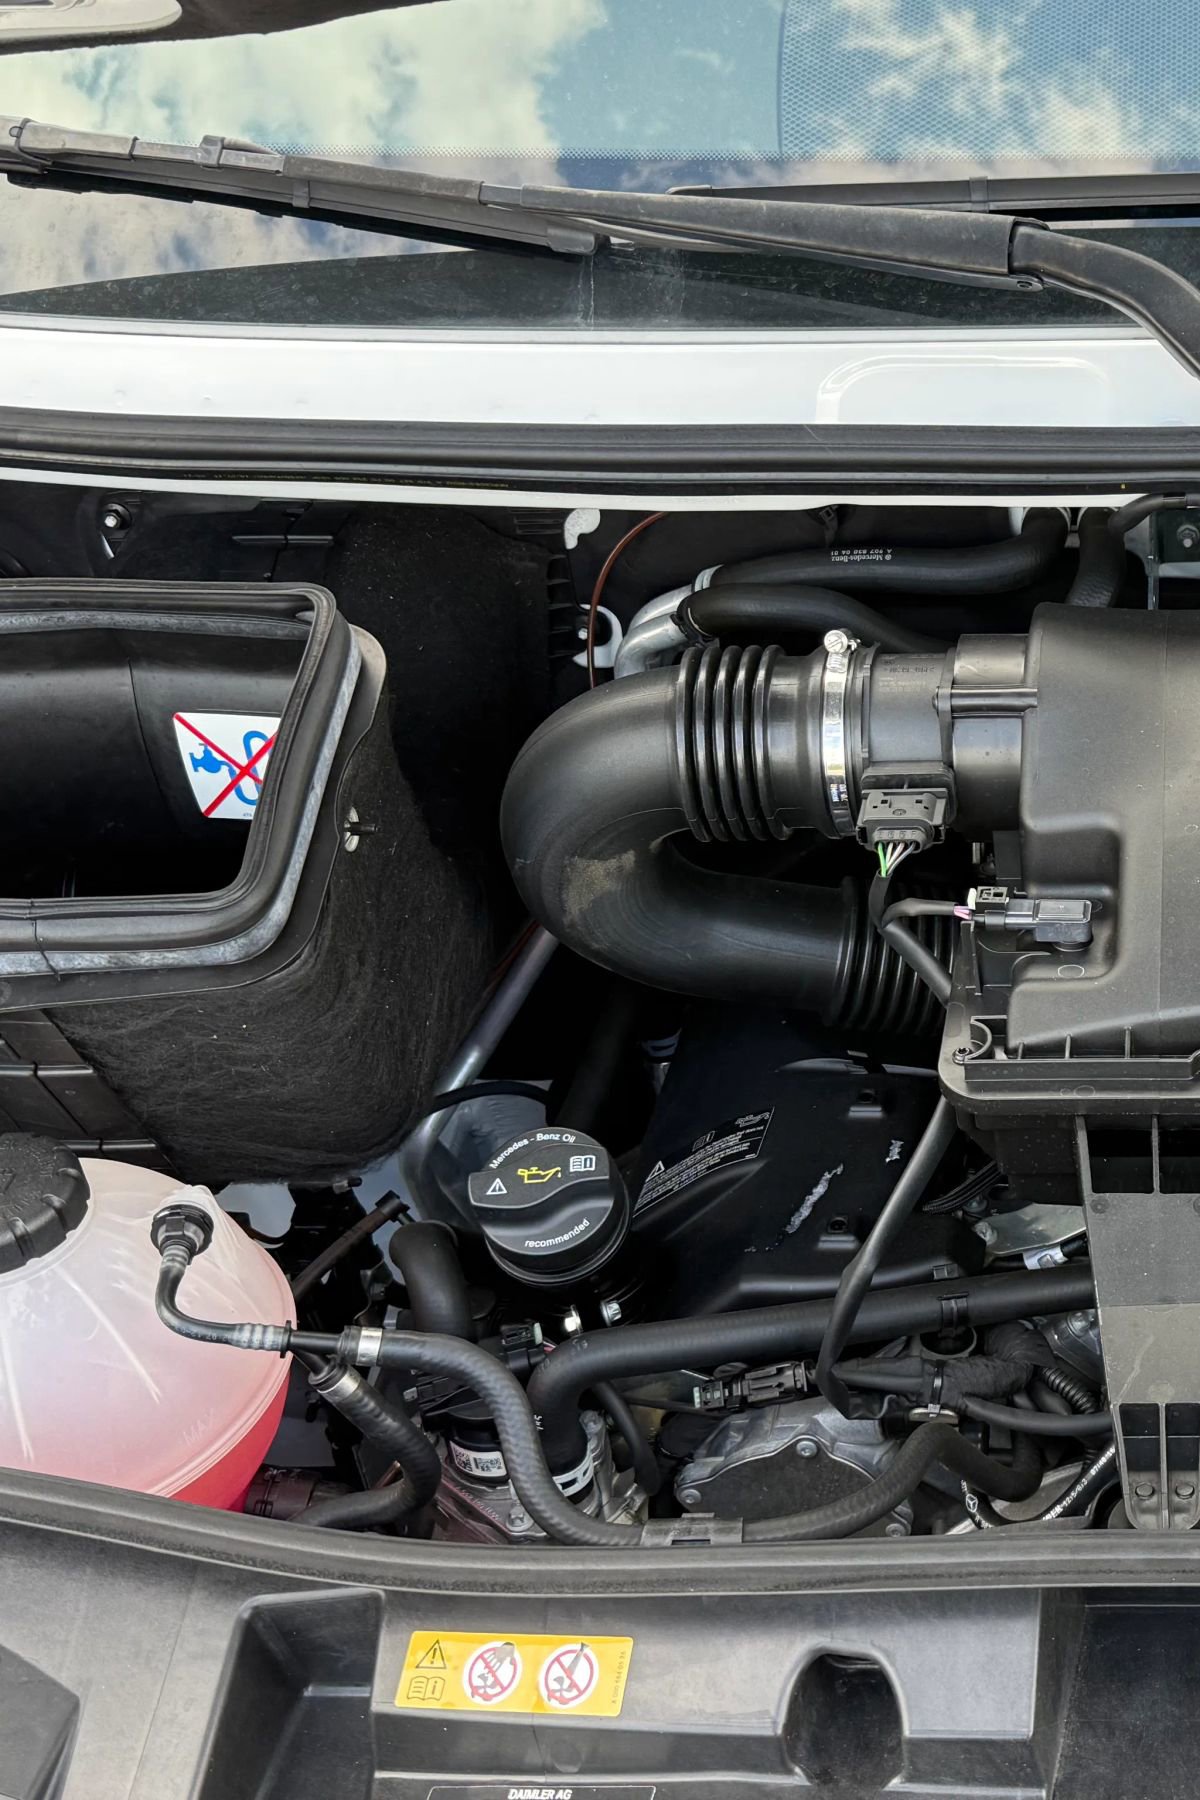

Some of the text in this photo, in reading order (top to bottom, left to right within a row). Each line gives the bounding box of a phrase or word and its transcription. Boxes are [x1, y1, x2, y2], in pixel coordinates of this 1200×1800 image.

[831, 554, 884, 562] Mercedes-Benz
[489, 1138, 530, 1169] Mercedes
[536, 1132, 561, 1142] Benz
[562, 1133, 576, 1143] Oil
[524, 1218, 591, 1248] recommended
[508, 1788, 573, 1800] DAIMLER AG
